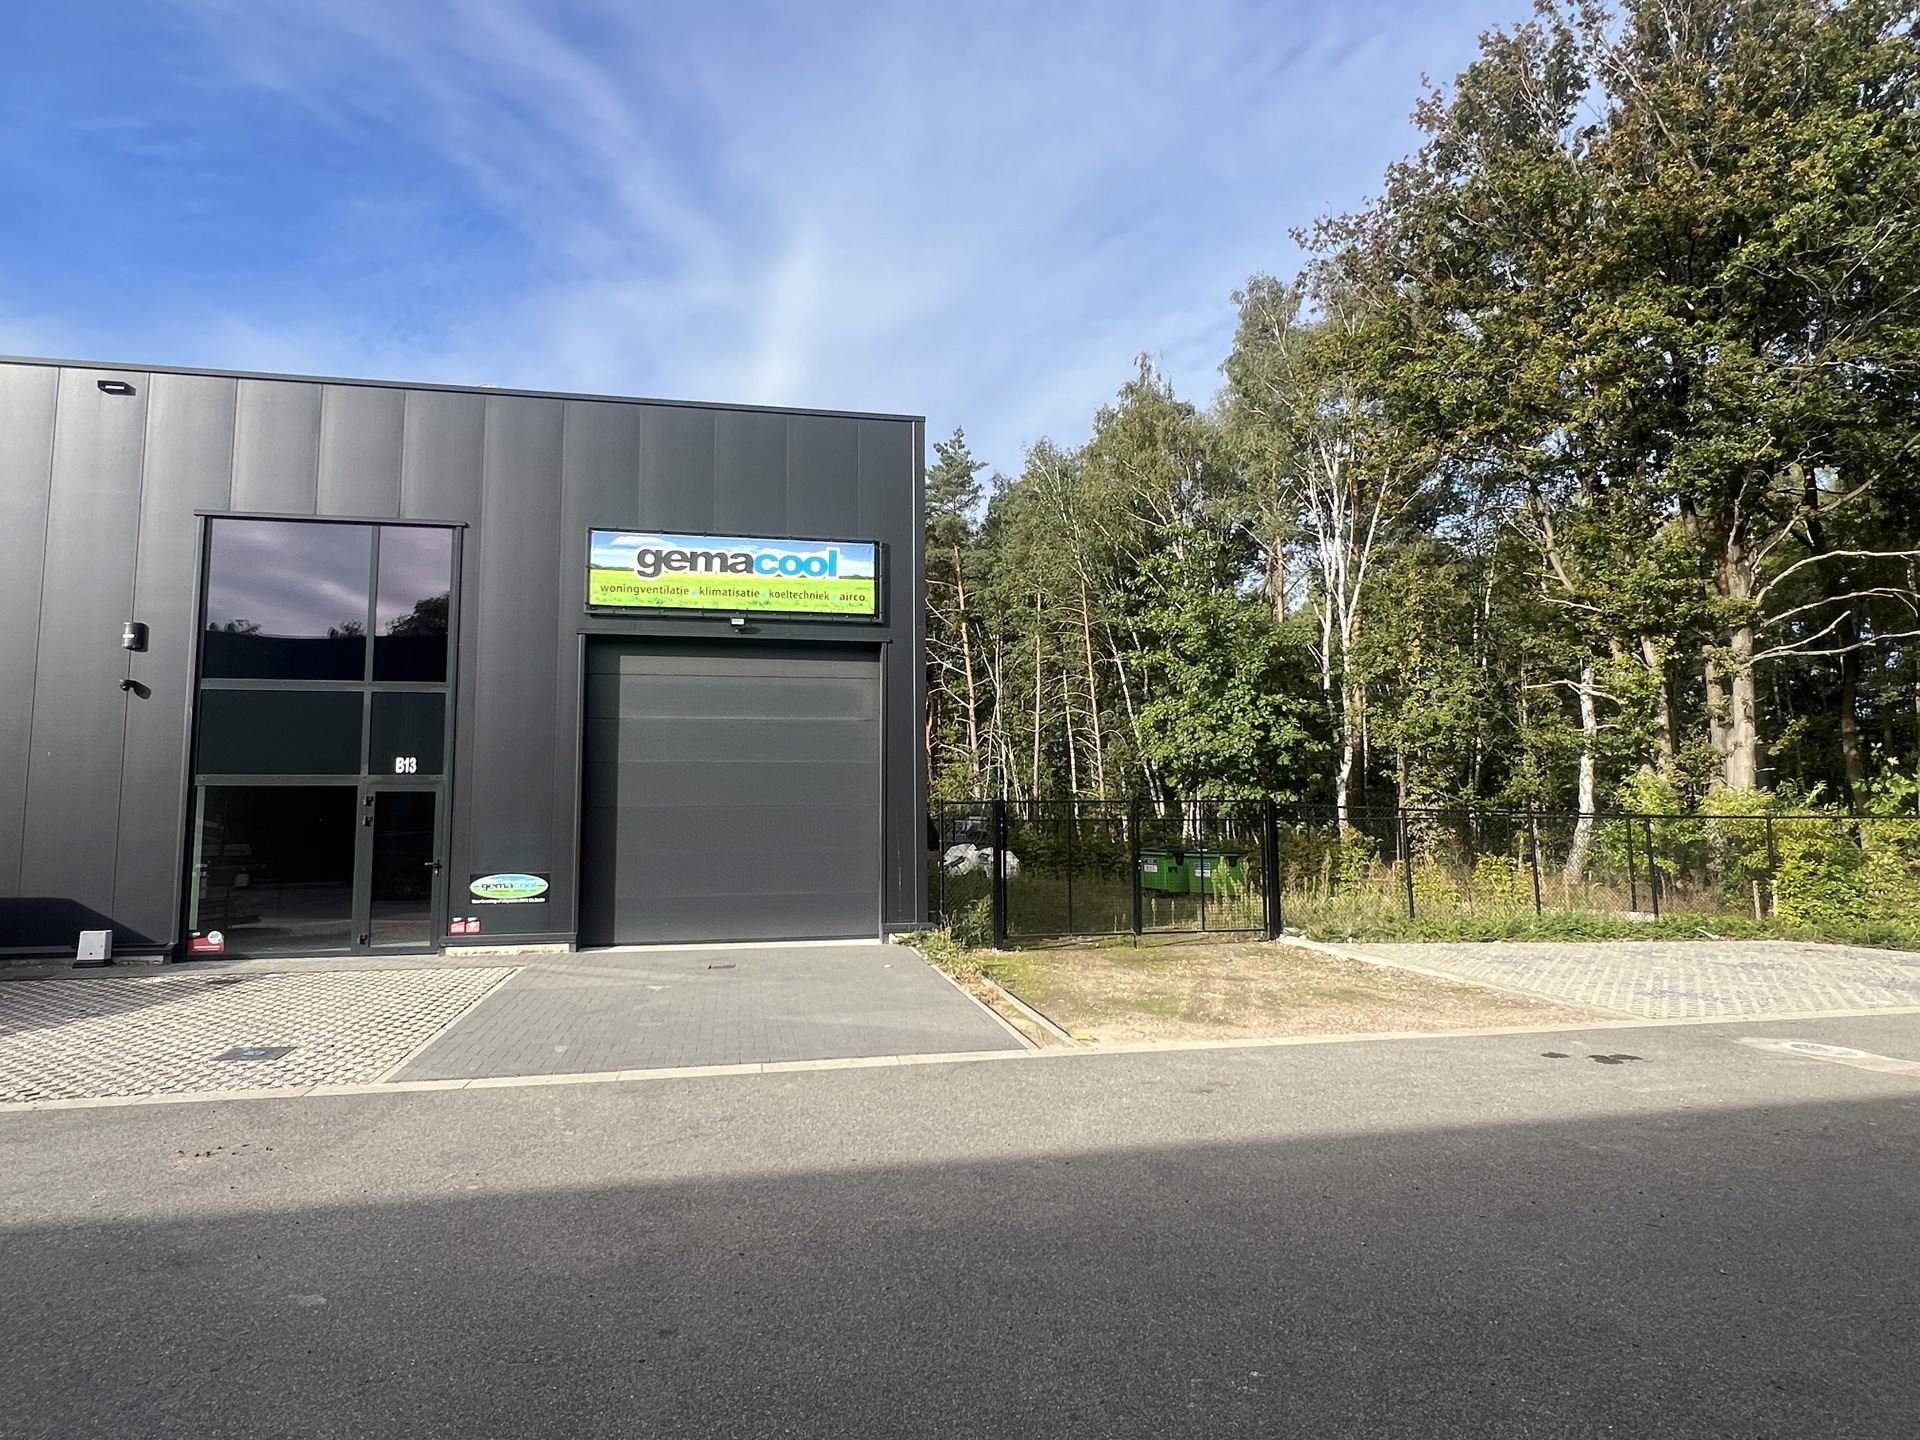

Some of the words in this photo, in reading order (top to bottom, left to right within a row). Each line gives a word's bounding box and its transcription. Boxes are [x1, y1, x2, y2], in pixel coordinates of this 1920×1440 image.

[637, 548, 837, 578] gemacool
[600, 584, 690, 597] woningventilatie
[699, 586, 760, 598] klimatisatie
[768, 588, 830, 601] koeltechniek
[839, 593, 866, 602] airco
[395, 756, 417, 774] B13
[481, 881, 537, 891] gemacool
